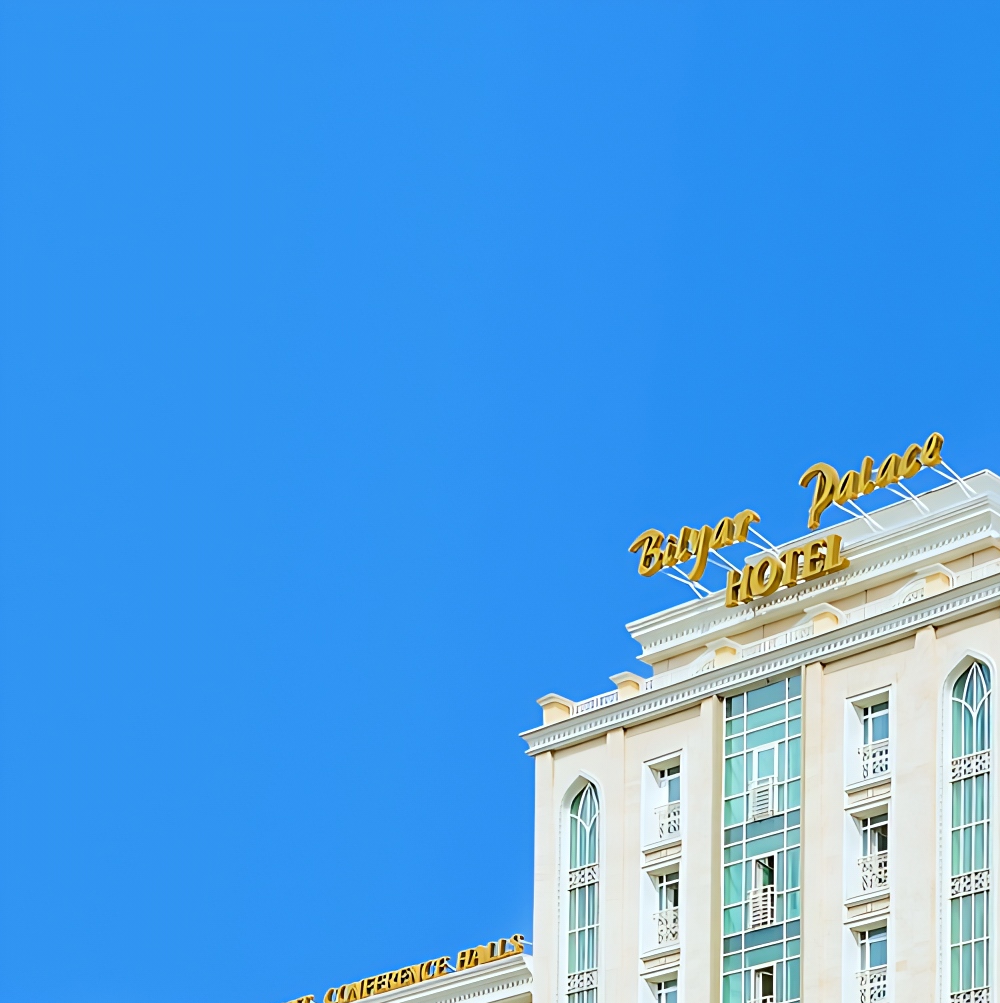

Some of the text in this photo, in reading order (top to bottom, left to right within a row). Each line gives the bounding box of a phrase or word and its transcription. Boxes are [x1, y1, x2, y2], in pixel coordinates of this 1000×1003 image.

[628, 431, 945, 582] Bilyar Palace
[725, 534, 851, 608] HOTEL
